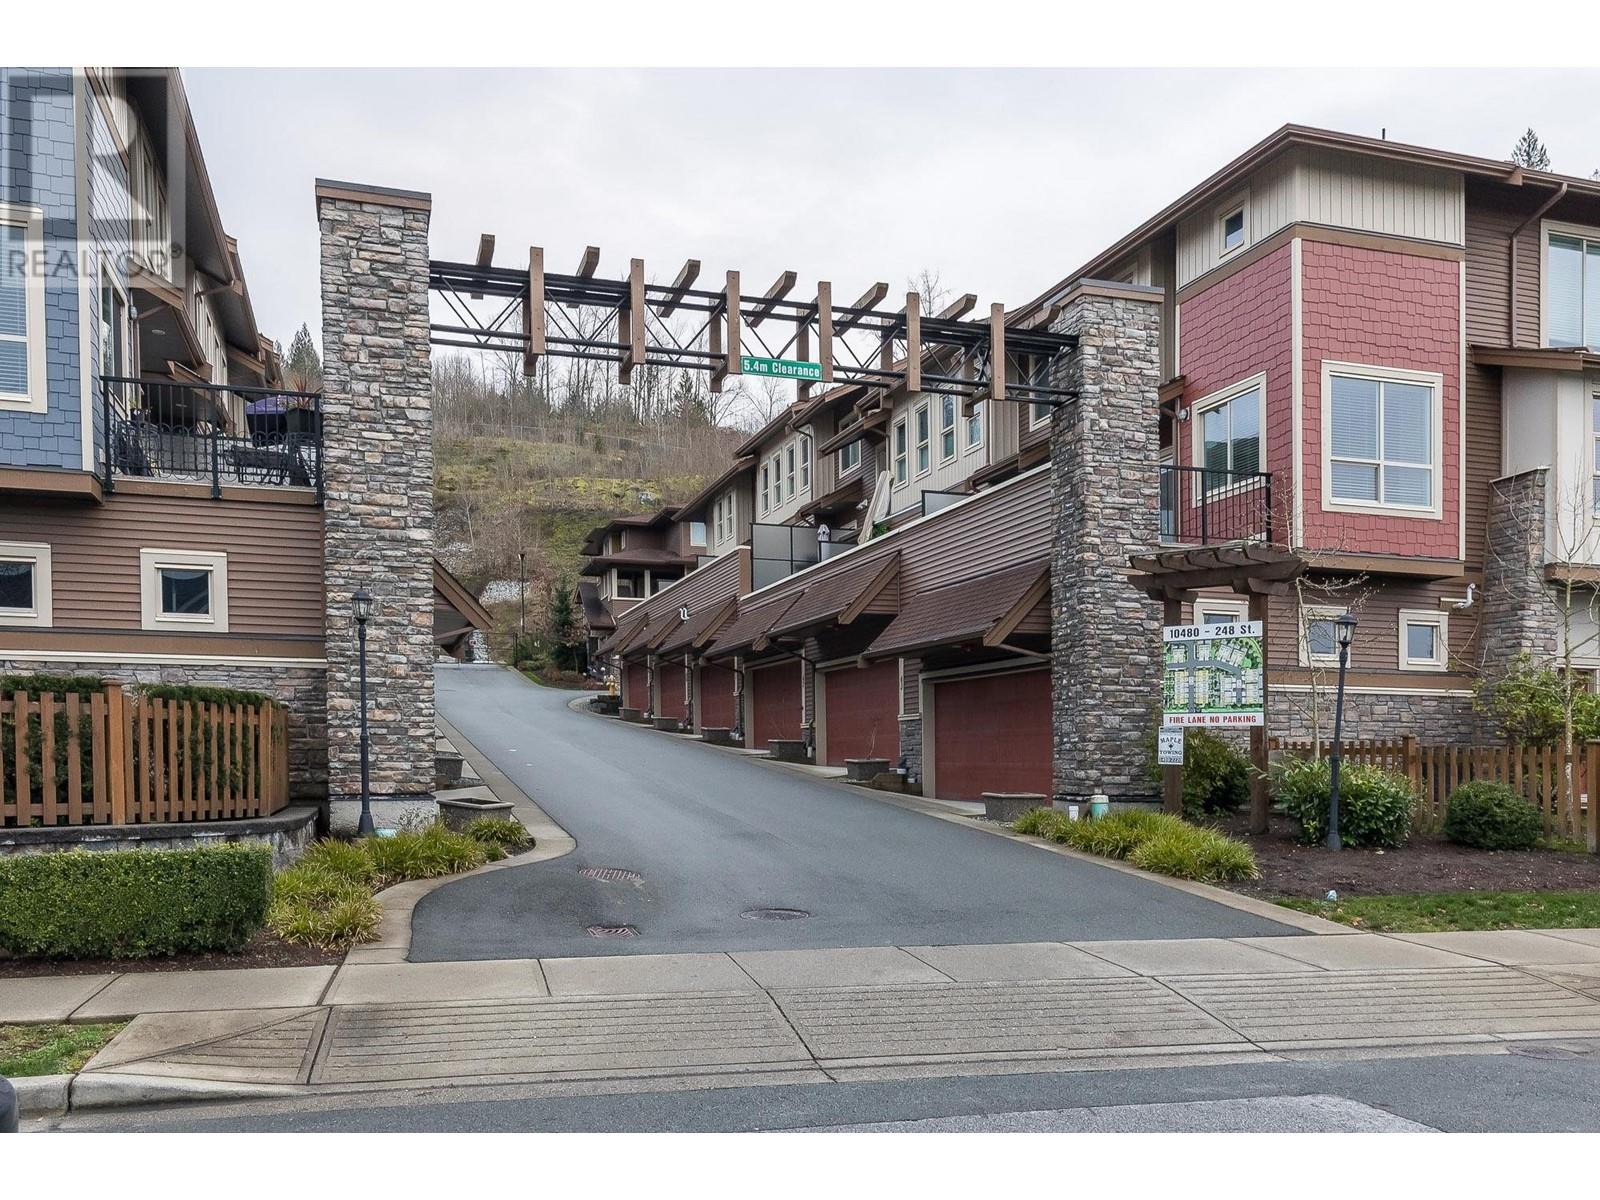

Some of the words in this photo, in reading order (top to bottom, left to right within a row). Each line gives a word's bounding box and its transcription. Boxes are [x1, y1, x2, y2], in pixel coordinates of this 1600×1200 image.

[744, 360, 768, 372] 5.4m
[772, 362, 820, 377] Clearance
[1170, 628, 1200, 639] 10480
[1215, 626, 1235, 636] 248
[1240, 625, 1255, 634] St.
[1169, 716, 1185, 724] FIRE
[1188, 716, 1206, 724] LANE
[1223, 715, 1257, 723] PARKING
[1160, 736, 1182, 745] MAPLE
